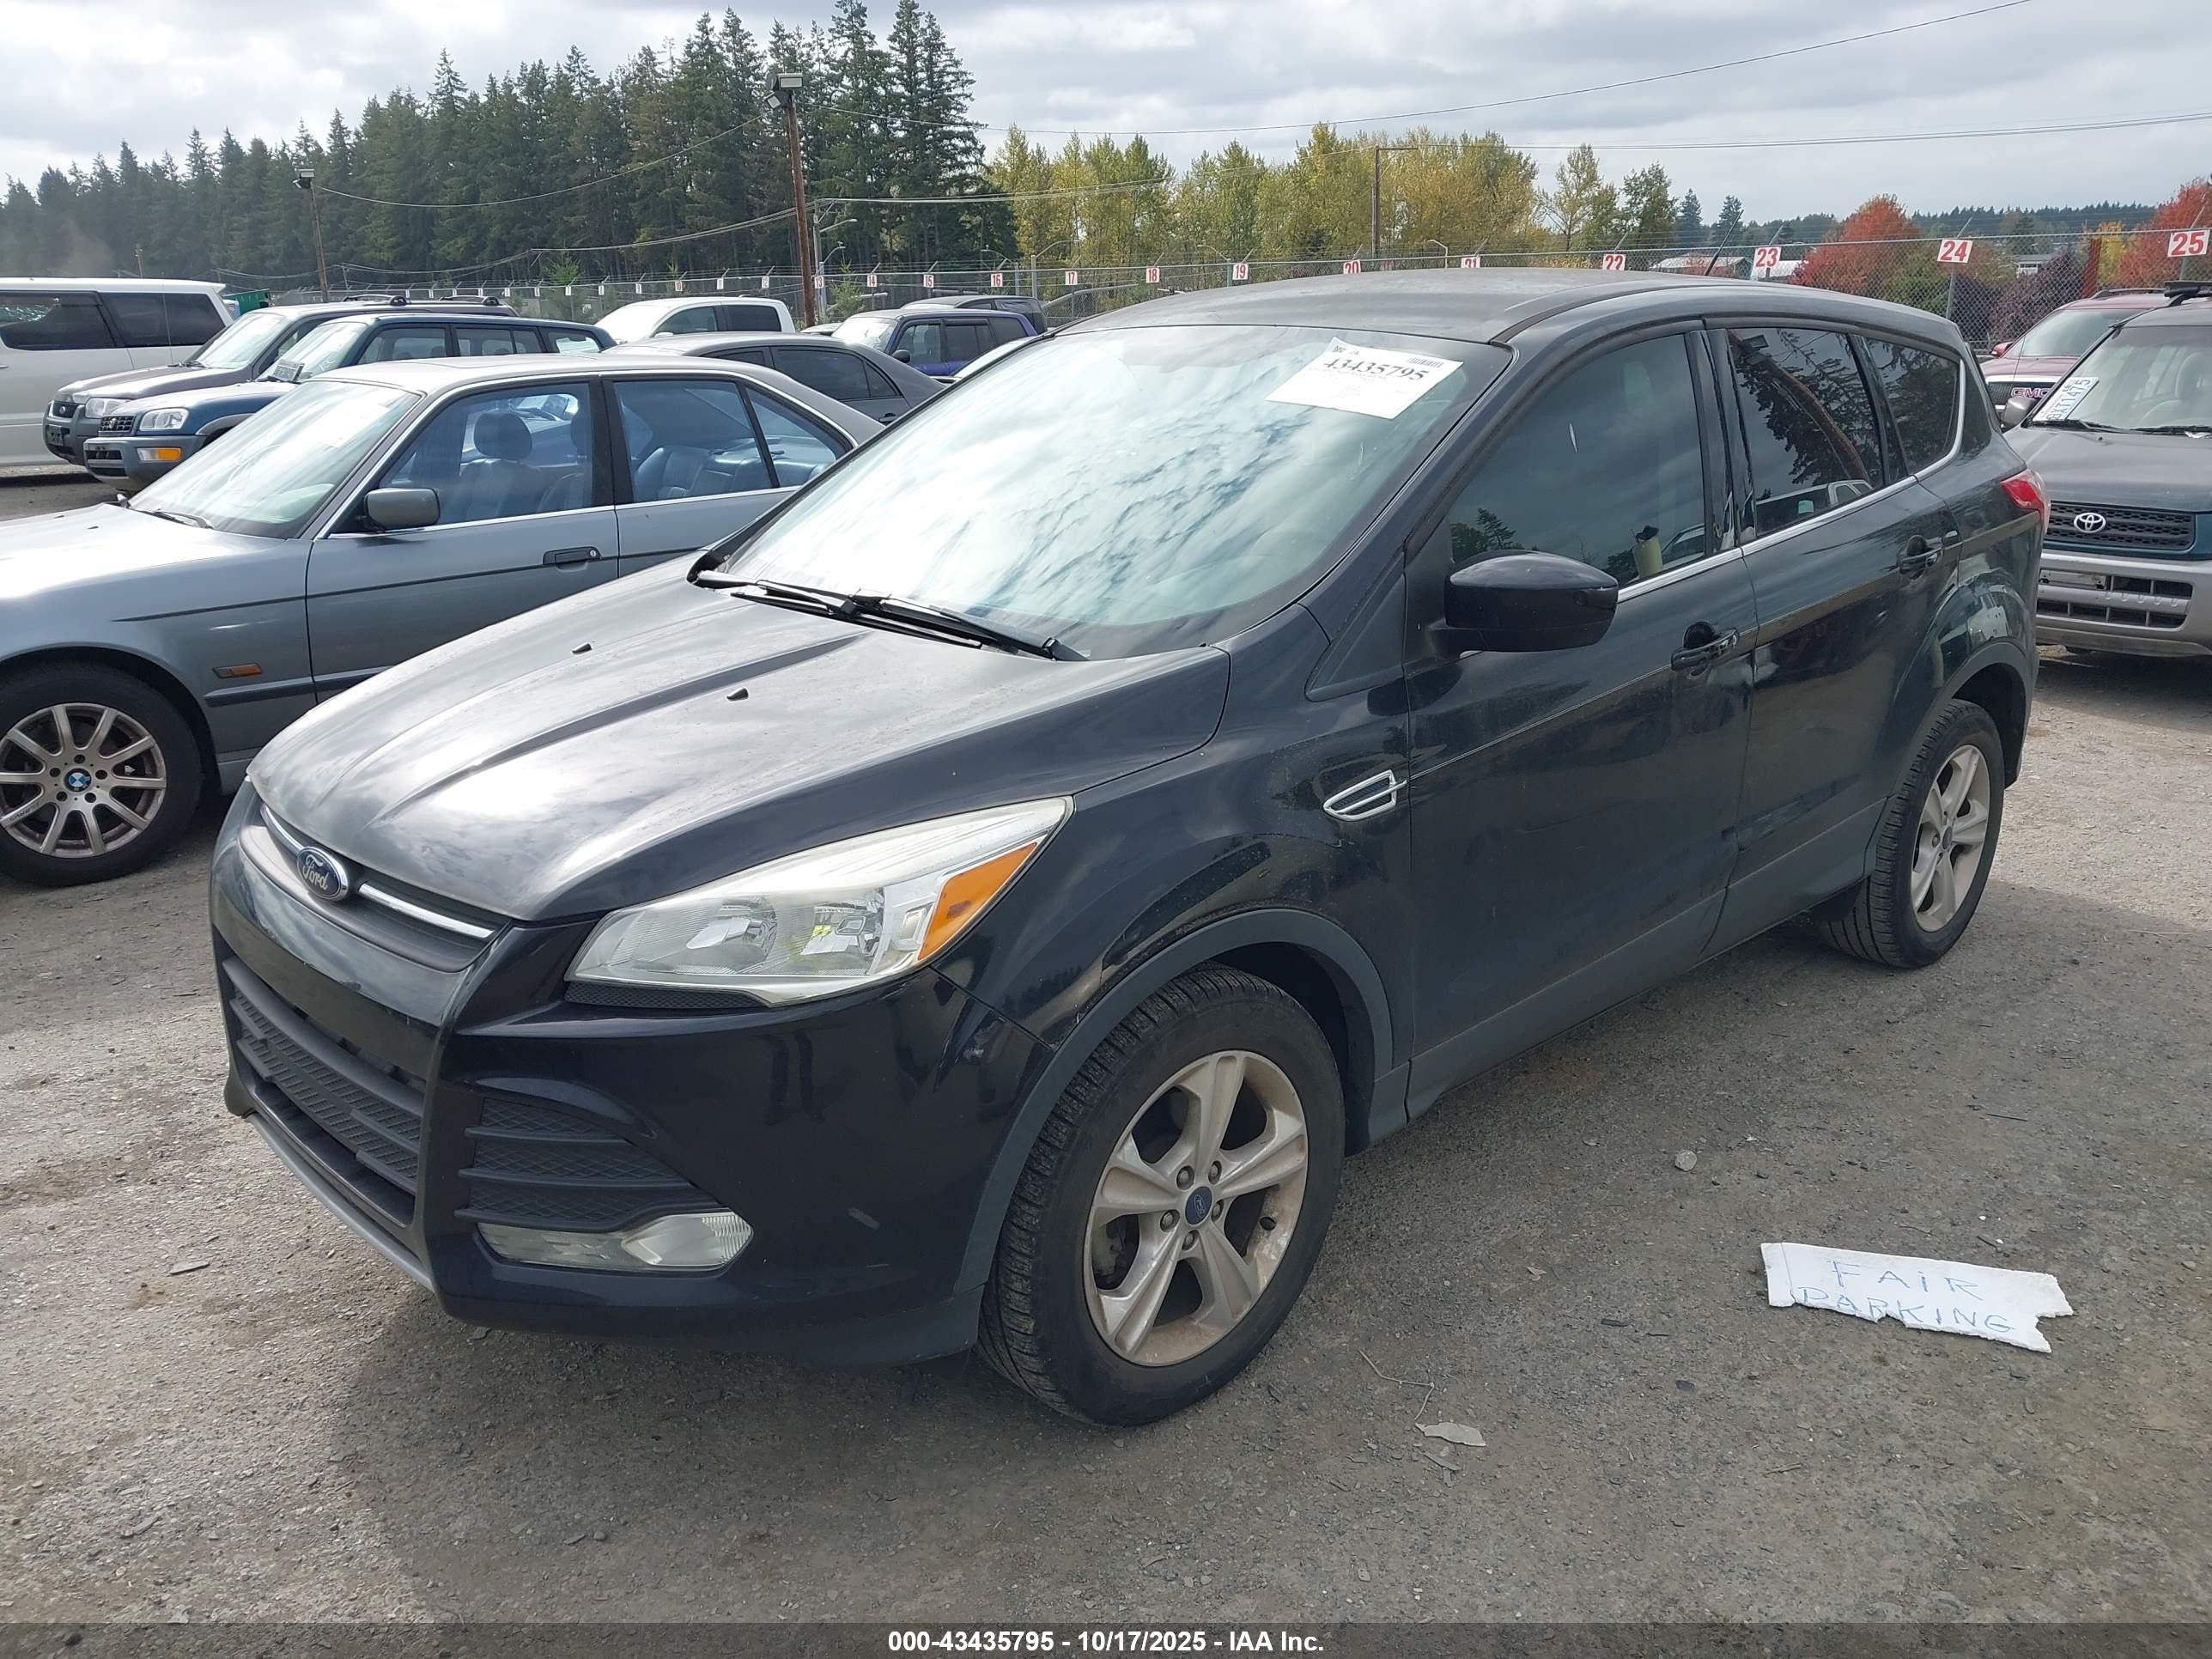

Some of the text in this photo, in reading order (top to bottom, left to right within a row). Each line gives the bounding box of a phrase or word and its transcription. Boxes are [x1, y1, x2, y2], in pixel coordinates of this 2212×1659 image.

[1940, 240, 1967, 261] 24
[2171, 232, 2204, 256] 25
[1605, 255, 1623, 270] 22
[1755, 247, 1778, 267] 23
[1147, 268, 1158, 282] 18
[1235, 264, 1246, 279] 19
[1346, 261, 1359, 274] 20
[868, 275, 876, 287] 14
[925, 275, 933, 288] 15
[993, 274, 1002, 286] 16
[1323, 357, 1430, 380] 43435795
[2011, 386, 2053, 398] GMC
[302, 854, 330, 890] Ford
[1797, 1285, 2016, 1333] PARKING
